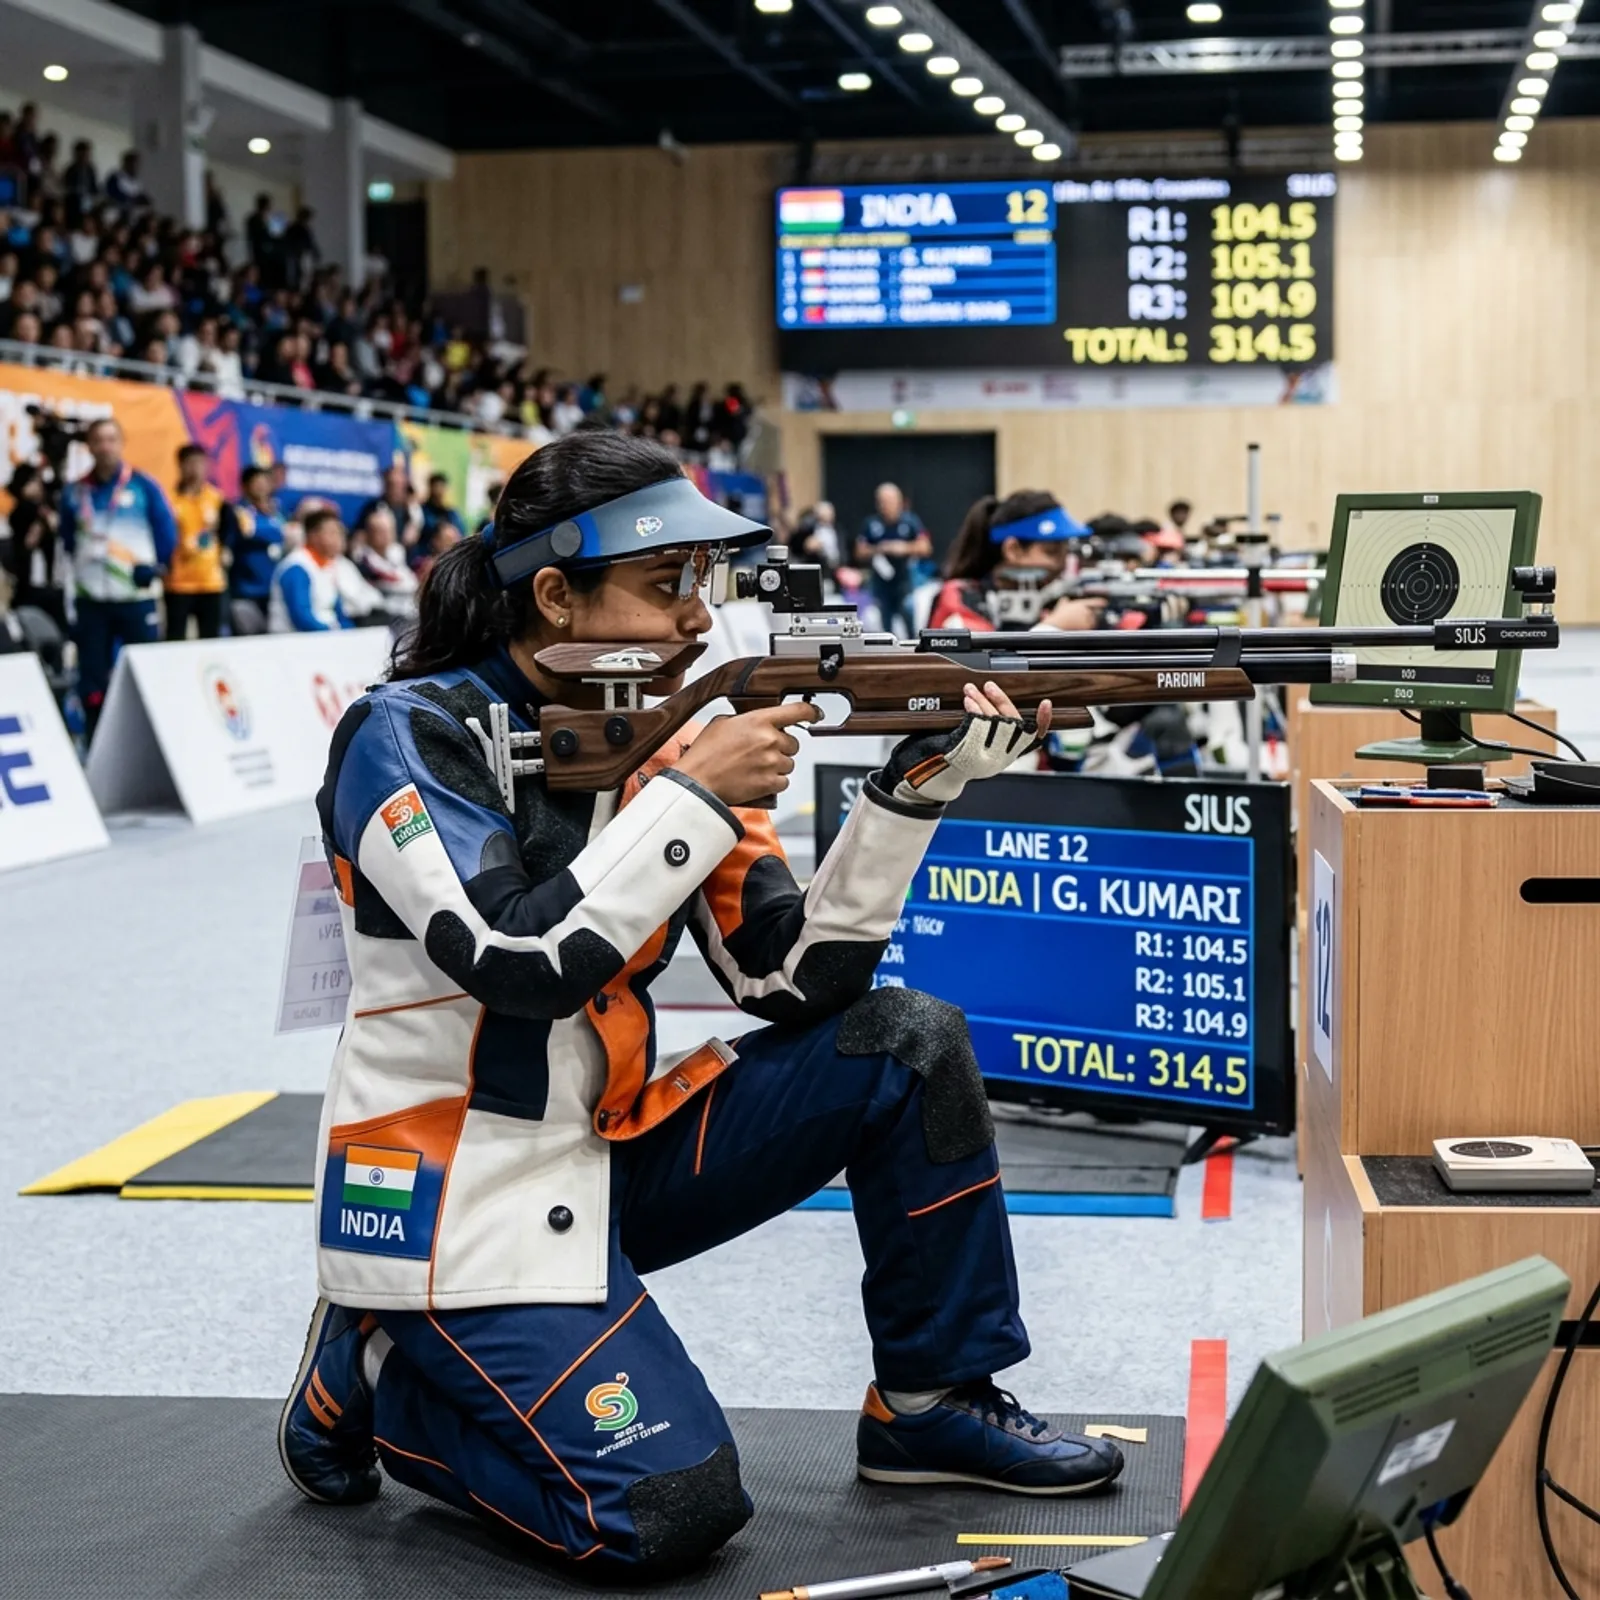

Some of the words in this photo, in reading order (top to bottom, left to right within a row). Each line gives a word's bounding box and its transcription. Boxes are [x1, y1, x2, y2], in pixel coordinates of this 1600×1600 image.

[861, 193, 956, 227] INDIA
[1007, 189, 1047, 223] 12
[1128, 207, 1186, 241] R1:
[1213, 202, 1316, 240] 104.5
[1128, 246, 1186, 280] R2:
[1212, 243, 1314, 279] 105.1
[1128, 284, 1186, 320] R3:
[1212, 281, 1316, 318] 104.9
[1064, 327, 1187, 363] TOTAL:
[1209, 324, 1316, 362] 314.5
[1185, 794, 1250, 833] SIUS
[987, 831, 1049, 859] LANE
[1060, 836, 1087, 861] 12
[929, 866, 1021, 905] INDIA
[1053, 876, 1086, 911] G.
[1101, 879, 1240, 923] KUMARI
[1135, 931, 1173, 958] R1:
[1182, 935, 1247, 965] 104.5
[1136, 967, 1173, 994] R2:
[1182, 972, 1246, 1002] 105.1
[1316, 899, 1330, 1039] 12
[1136, 1003, 1173, 1030] R3:
[1182, 1008, 1247, 1038] 104.9
[1014, 1034, 1134, 1081] TOTAL:
[1150, 1049, 1245, 1094] 314.5
[341, 1209, 404, 1241] INDIA
